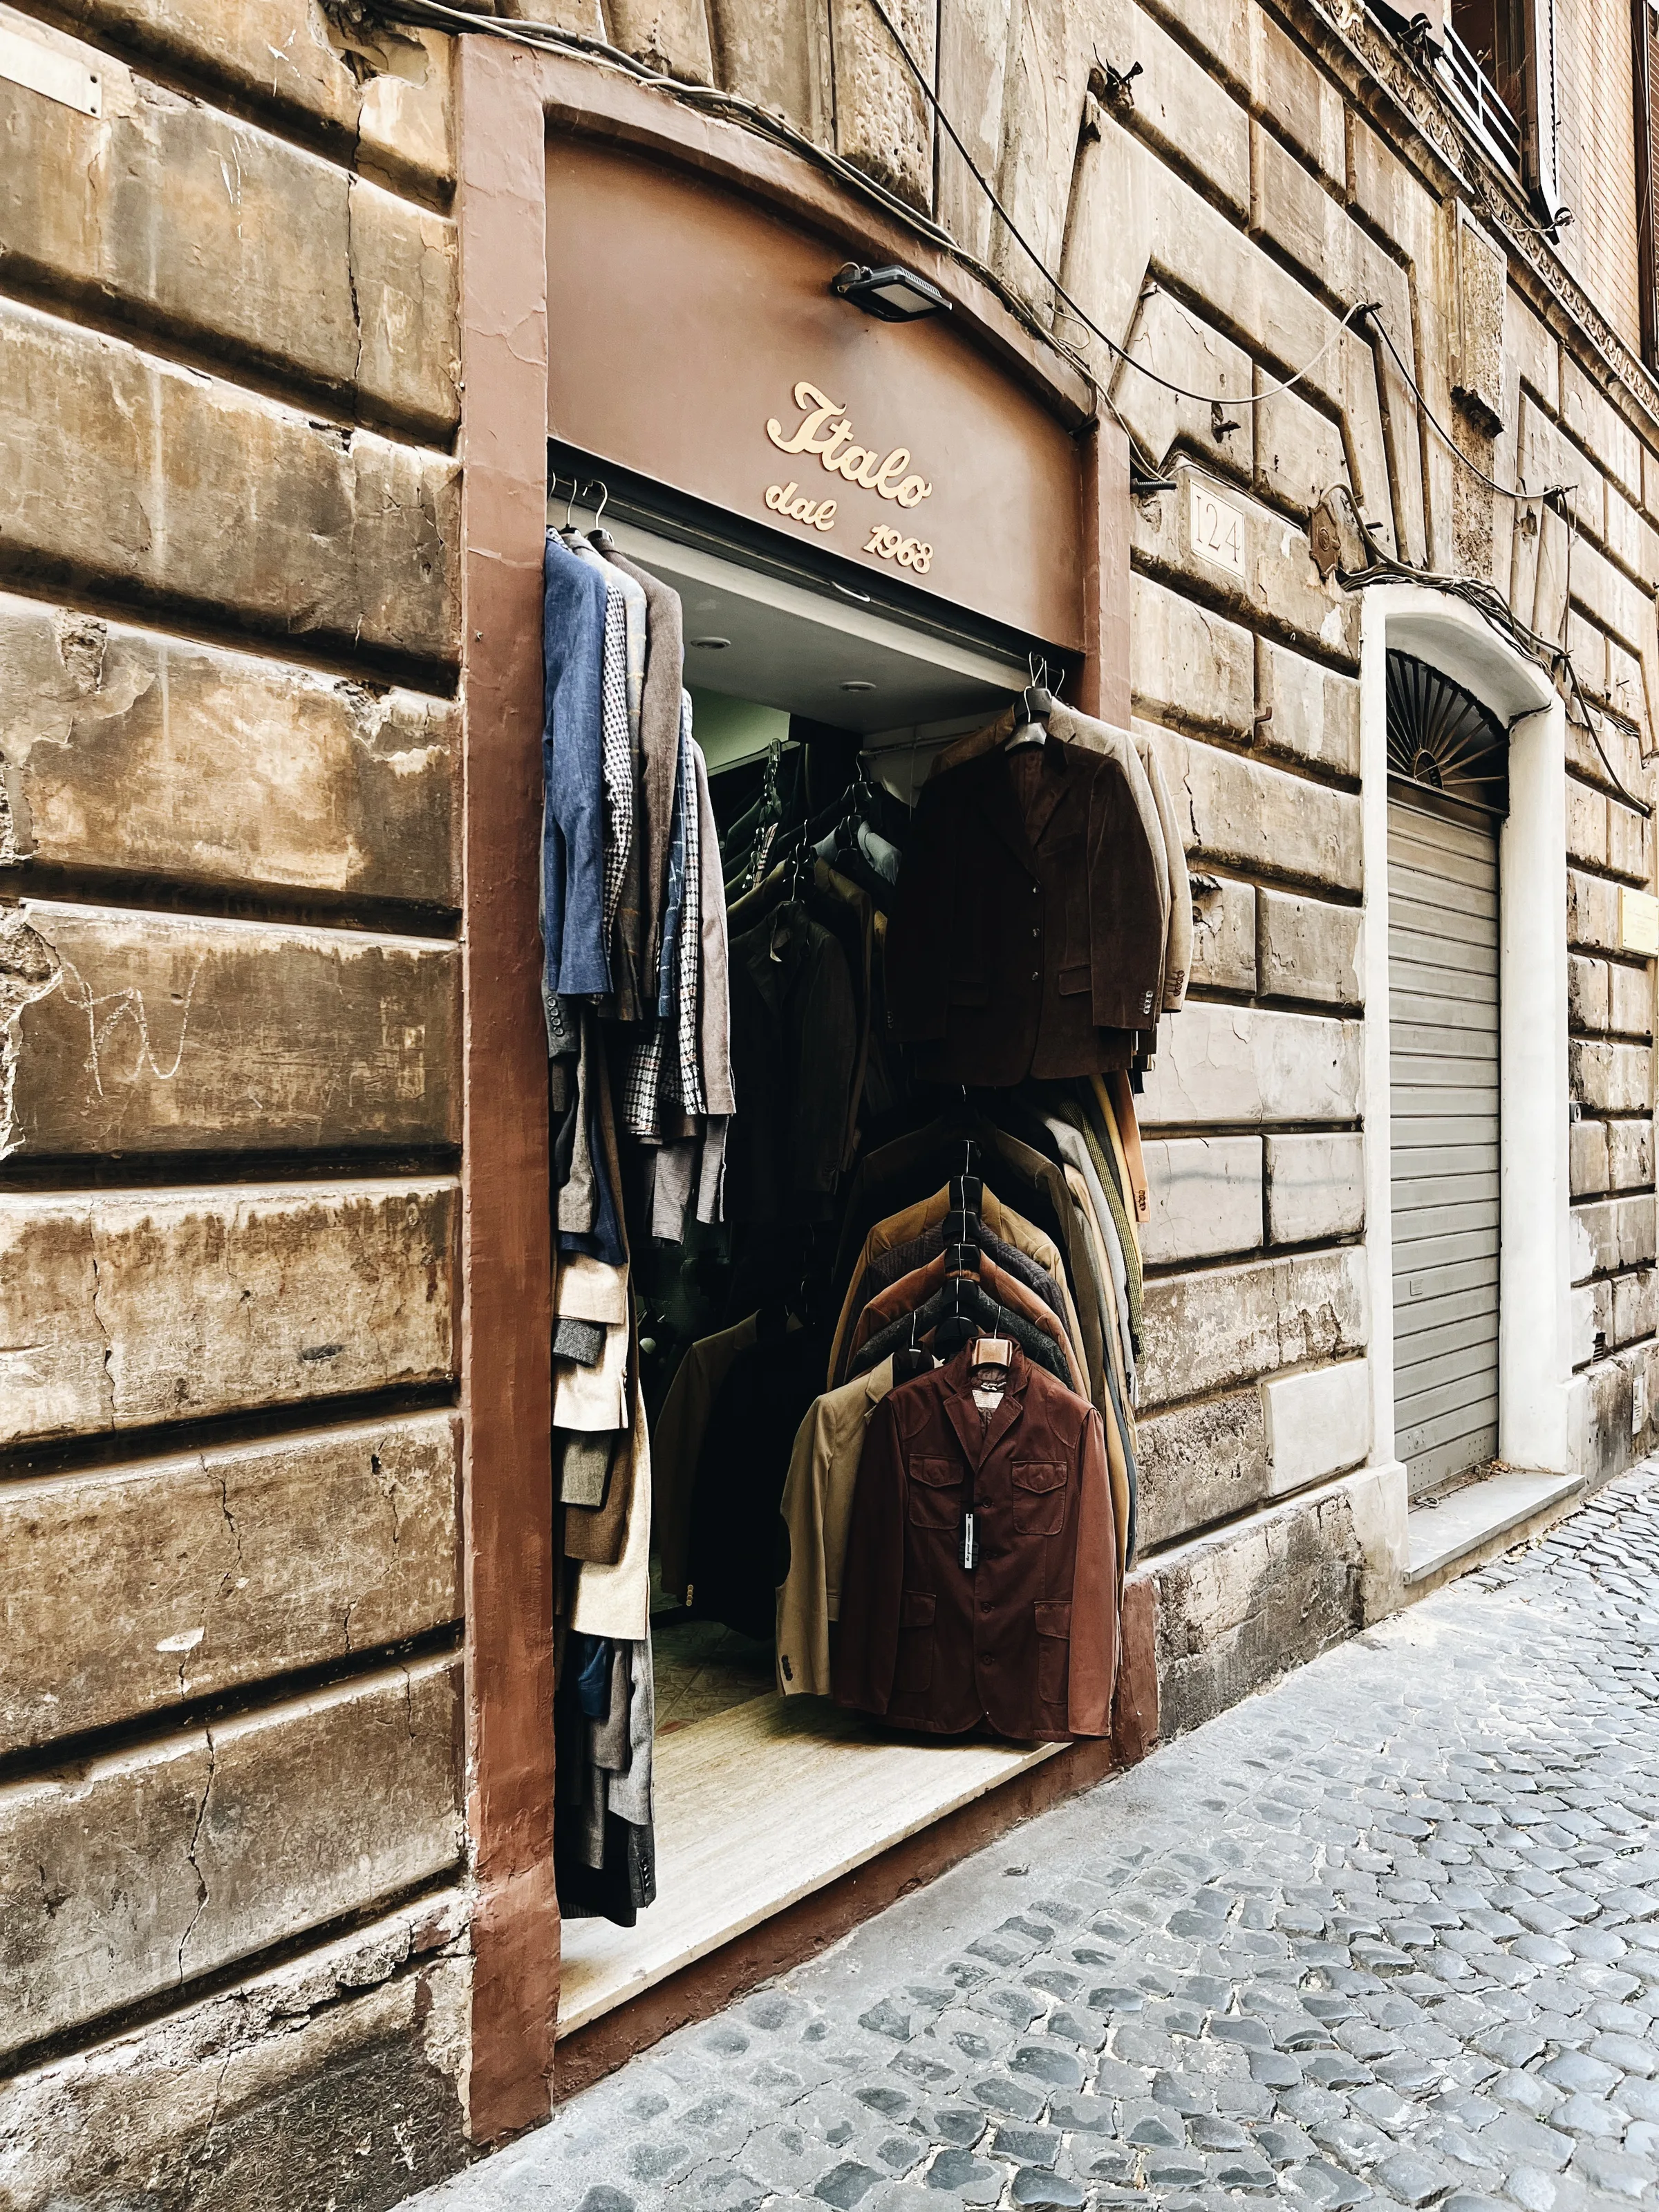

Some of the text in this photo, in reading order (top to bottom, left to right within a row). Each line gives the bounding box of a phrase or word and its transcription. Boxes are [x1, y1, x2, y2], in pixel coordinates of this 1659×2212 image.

[767, 382, 932, 508] Italo
[765, 482, 934, 574] dal 1968
[1197, 495, 1241, 563] 124
